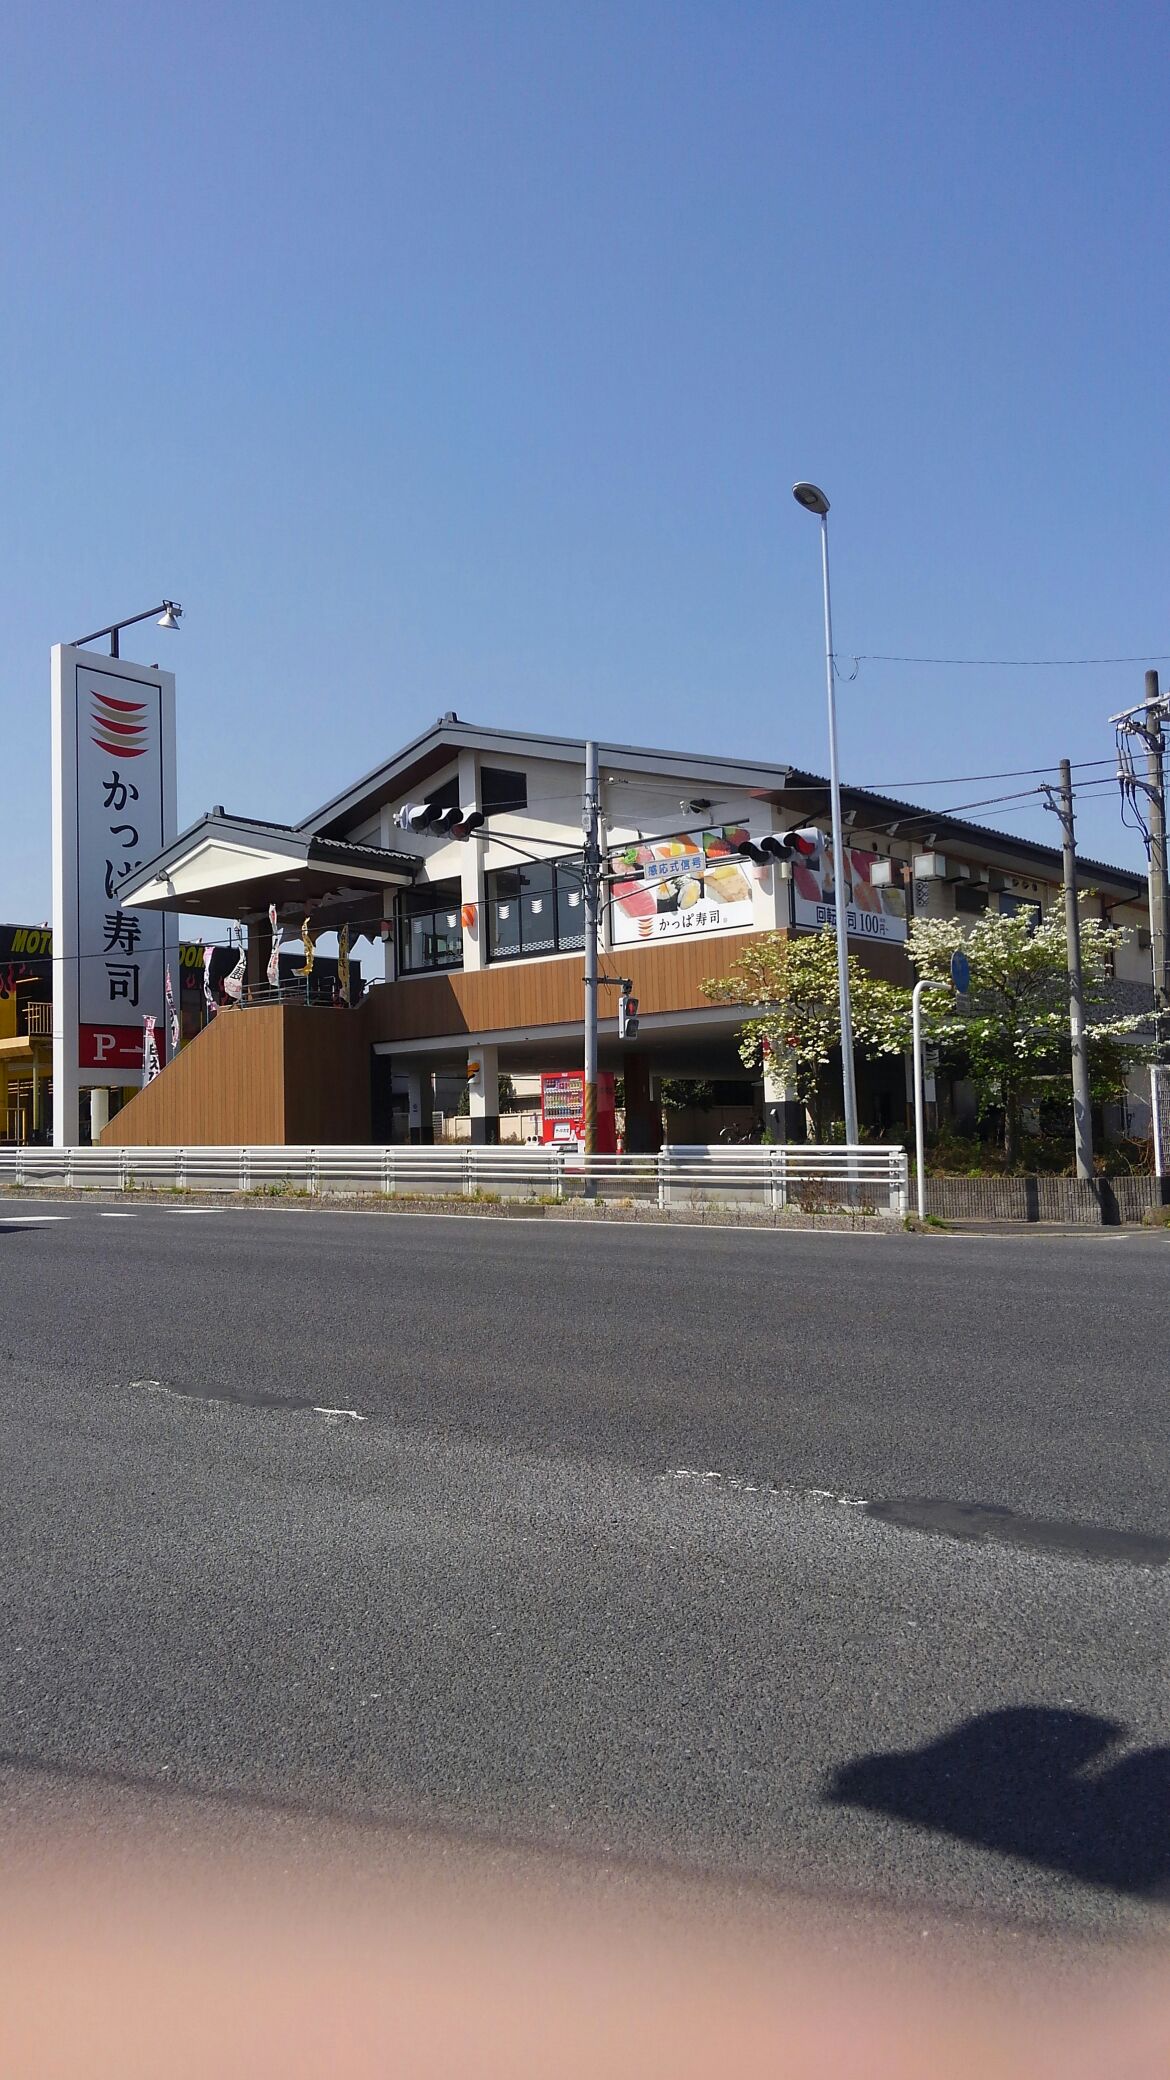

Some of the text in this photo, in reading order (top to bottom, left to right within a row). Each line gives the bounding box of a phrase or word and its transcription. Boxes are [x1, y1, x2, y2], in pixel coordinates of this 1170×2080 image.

[648, 856, 701, 876] 感応式信号
[659, 909, 720, 932] かっぱ寿司
[816, 905, 857, 930] 回転司
[93, 1033, 116, 1061] P
